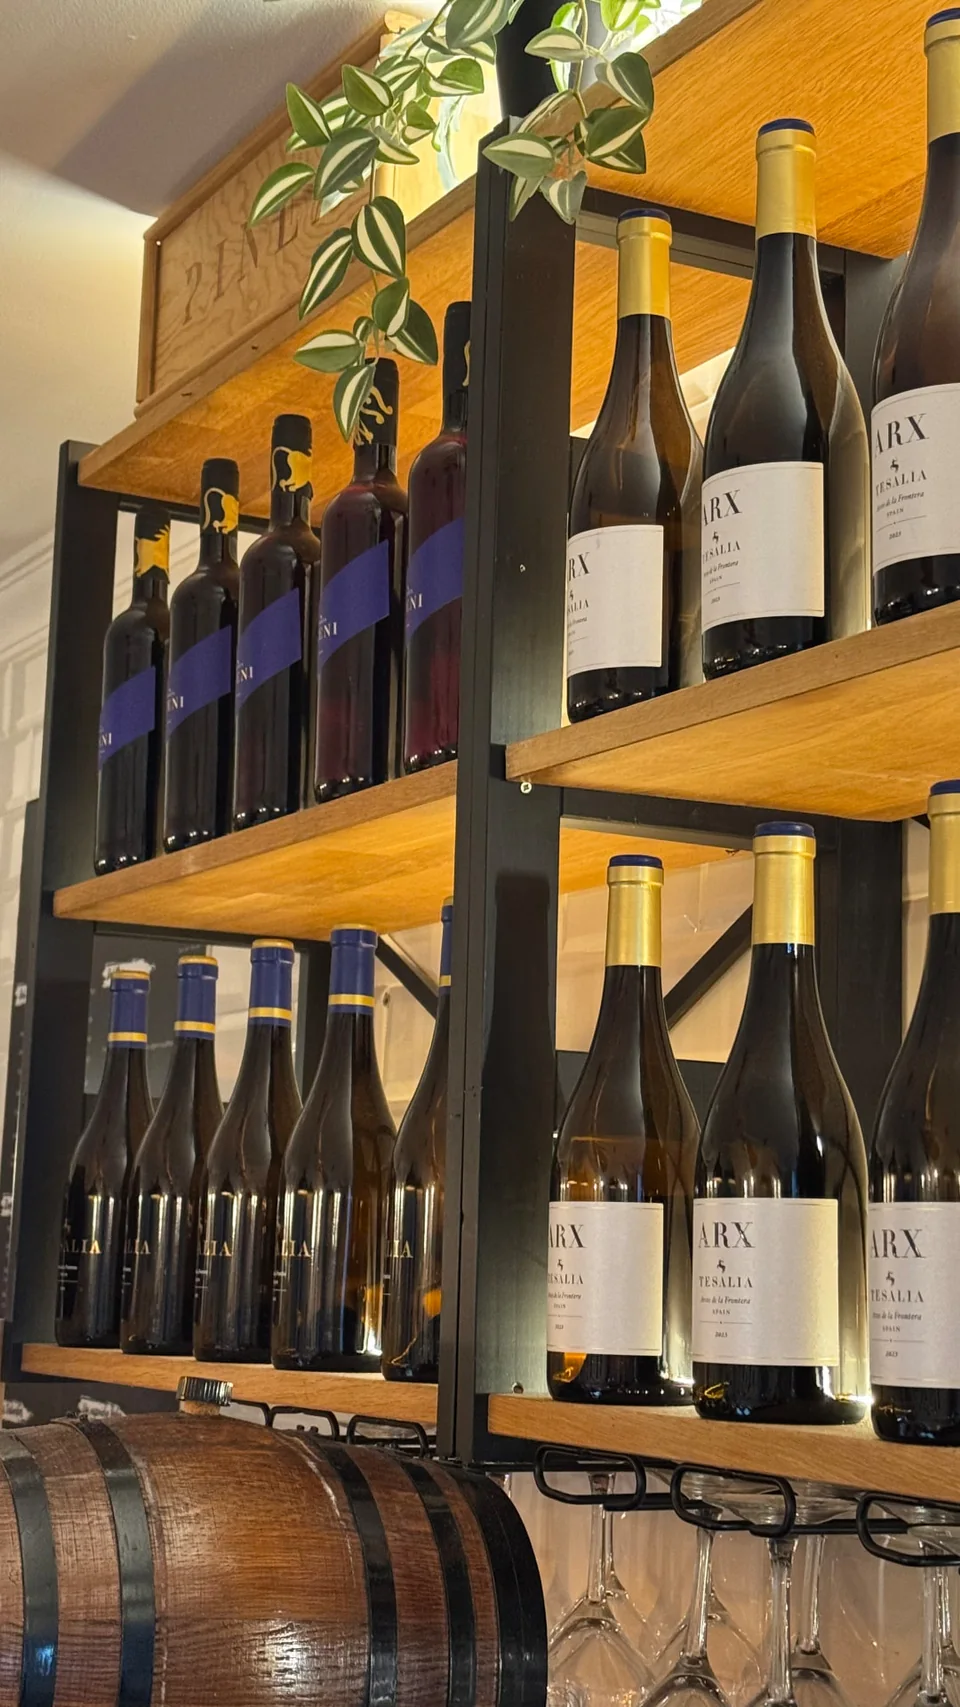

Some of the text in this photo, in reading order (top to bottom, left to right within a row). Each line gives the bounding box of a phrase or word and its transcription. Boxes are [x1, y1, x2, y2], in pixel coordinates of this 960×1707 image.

[874, 413, 930, 459] ARX
[698, 1221, 756, 1249] ARX
[871, 1229, 927, 1259] ARX
[699, 1276, 753, 1288] TESALIA
[724, 1296, 751, 1305] Frontera
[871, 1288, 924, 1303] TESALIA
